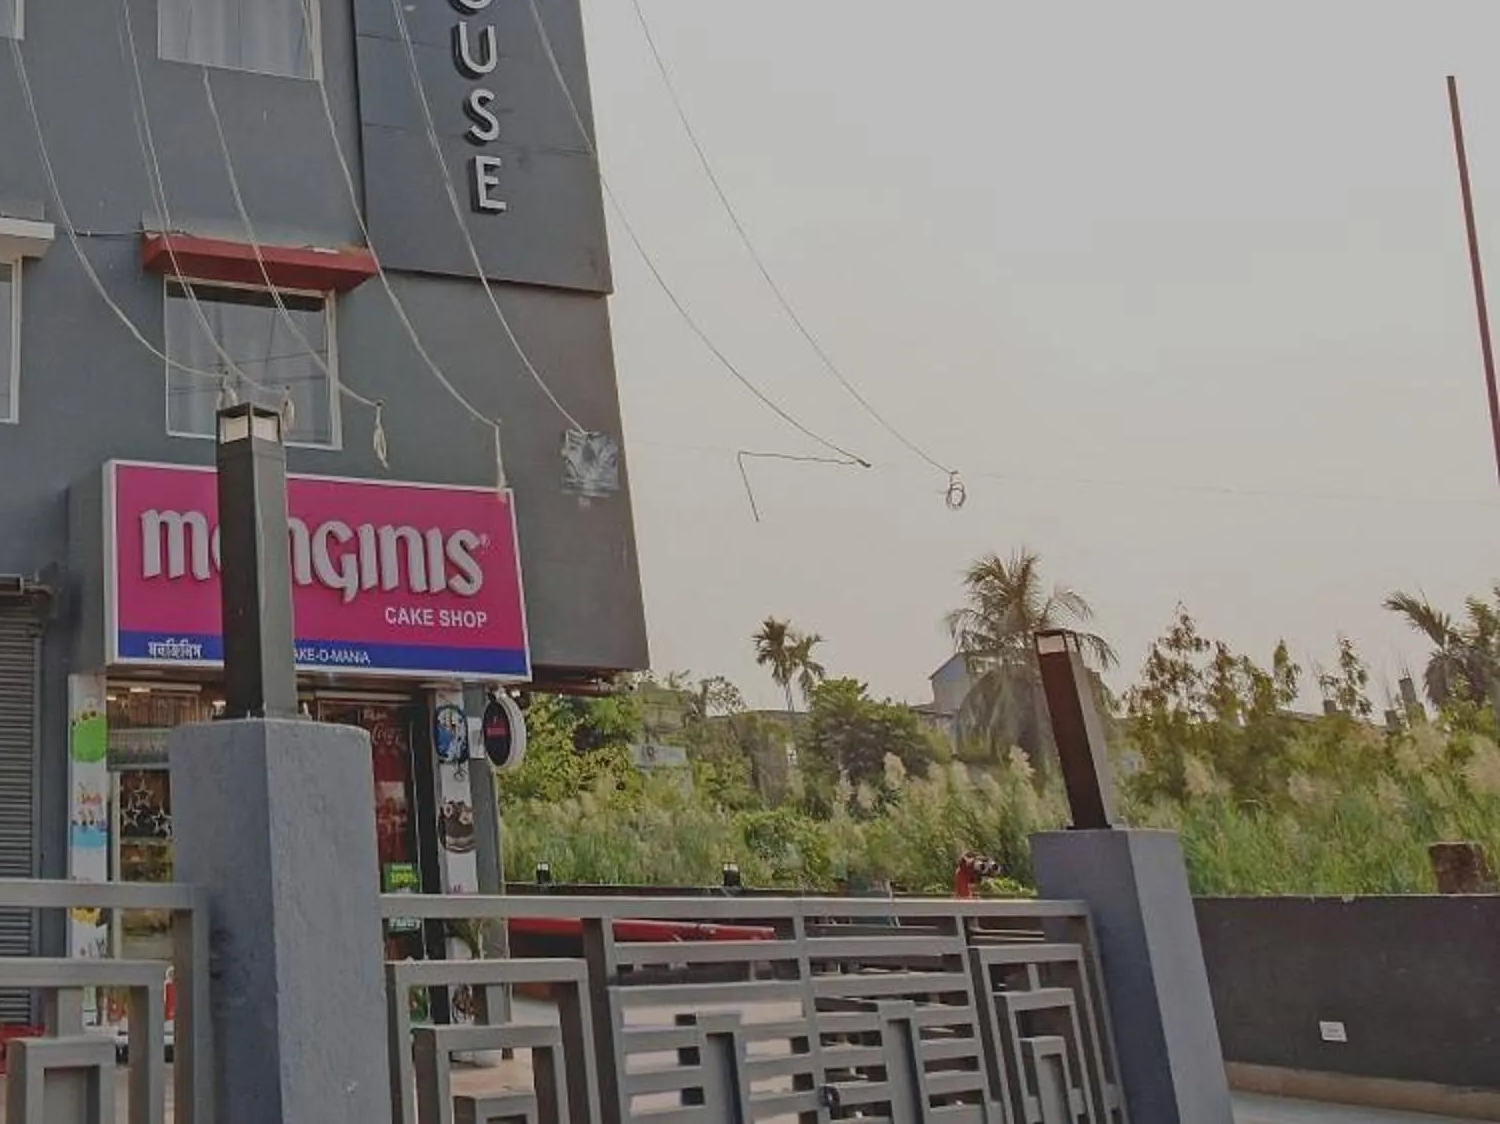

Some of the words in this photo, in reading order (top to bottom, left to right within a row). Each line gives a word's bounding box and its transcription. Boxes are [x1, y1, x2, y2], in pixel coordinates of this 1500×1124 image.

[141, 508, 484, 603] mnginis
[385, 607, 434, 628] CAKE
[439, 609, 488, 630] SHOP
[293, 646, 371, 665] AKE-O-MANIA
